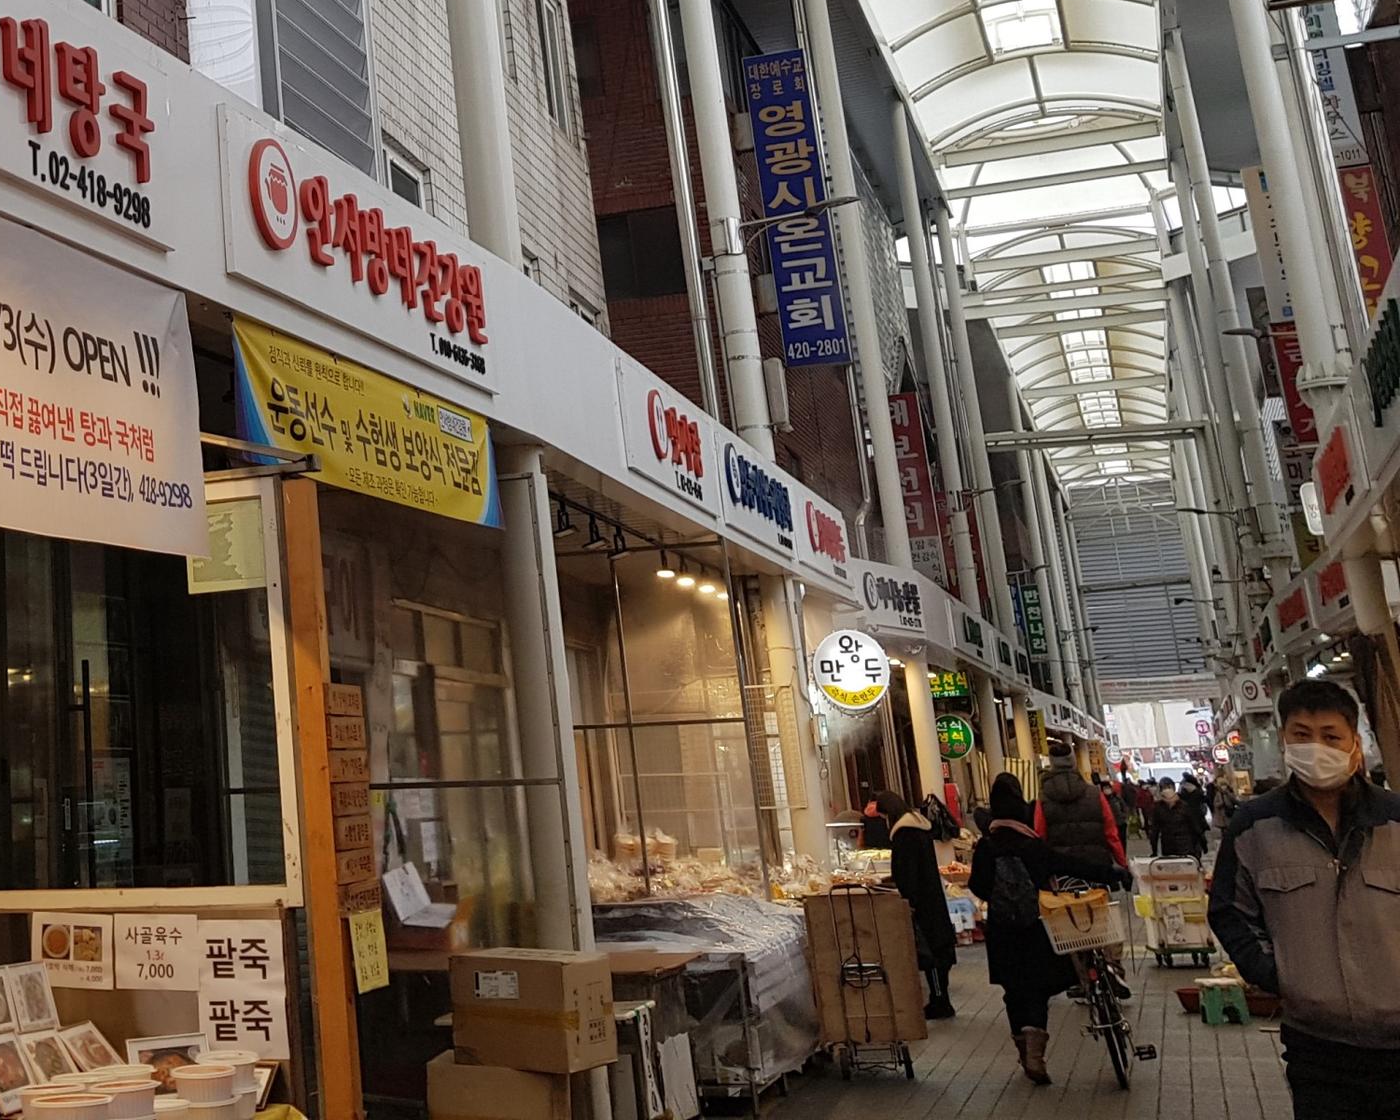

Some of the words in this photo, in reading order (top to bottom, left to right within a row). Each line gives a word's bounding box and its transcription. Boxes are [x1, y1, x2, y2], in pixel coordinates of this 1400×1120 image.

[748, 57, 804, 79] 대한예수교
[758, 99, 836, 330] 영광시온교회
[63, 326, 131, 387] OPEN
[787, 337, 848, 360] 420-2801
[27, 396, 76, 443] 끓여낸
[79, 410, 113, 452] 탕과
[115, 419, 155, 464] 국처럼
[266, 377, 337, 450] 운동선수
[341, 419, 354, 454] 및
[355, 409, 401, 472] 수험생
[401, 426, 447, 486] 보양식
[443, 443, 483, 497] 전문점
[0, 440, 16, 480] 떡
[138, 474, 193, 509] 418-9298
[125, 926, 183, 946] 사골육수
[136, 963, 174, 979] 7,000
[205, 937, 270, 980] 팥죽
[209, 999, 273, 1042] 팥죽
